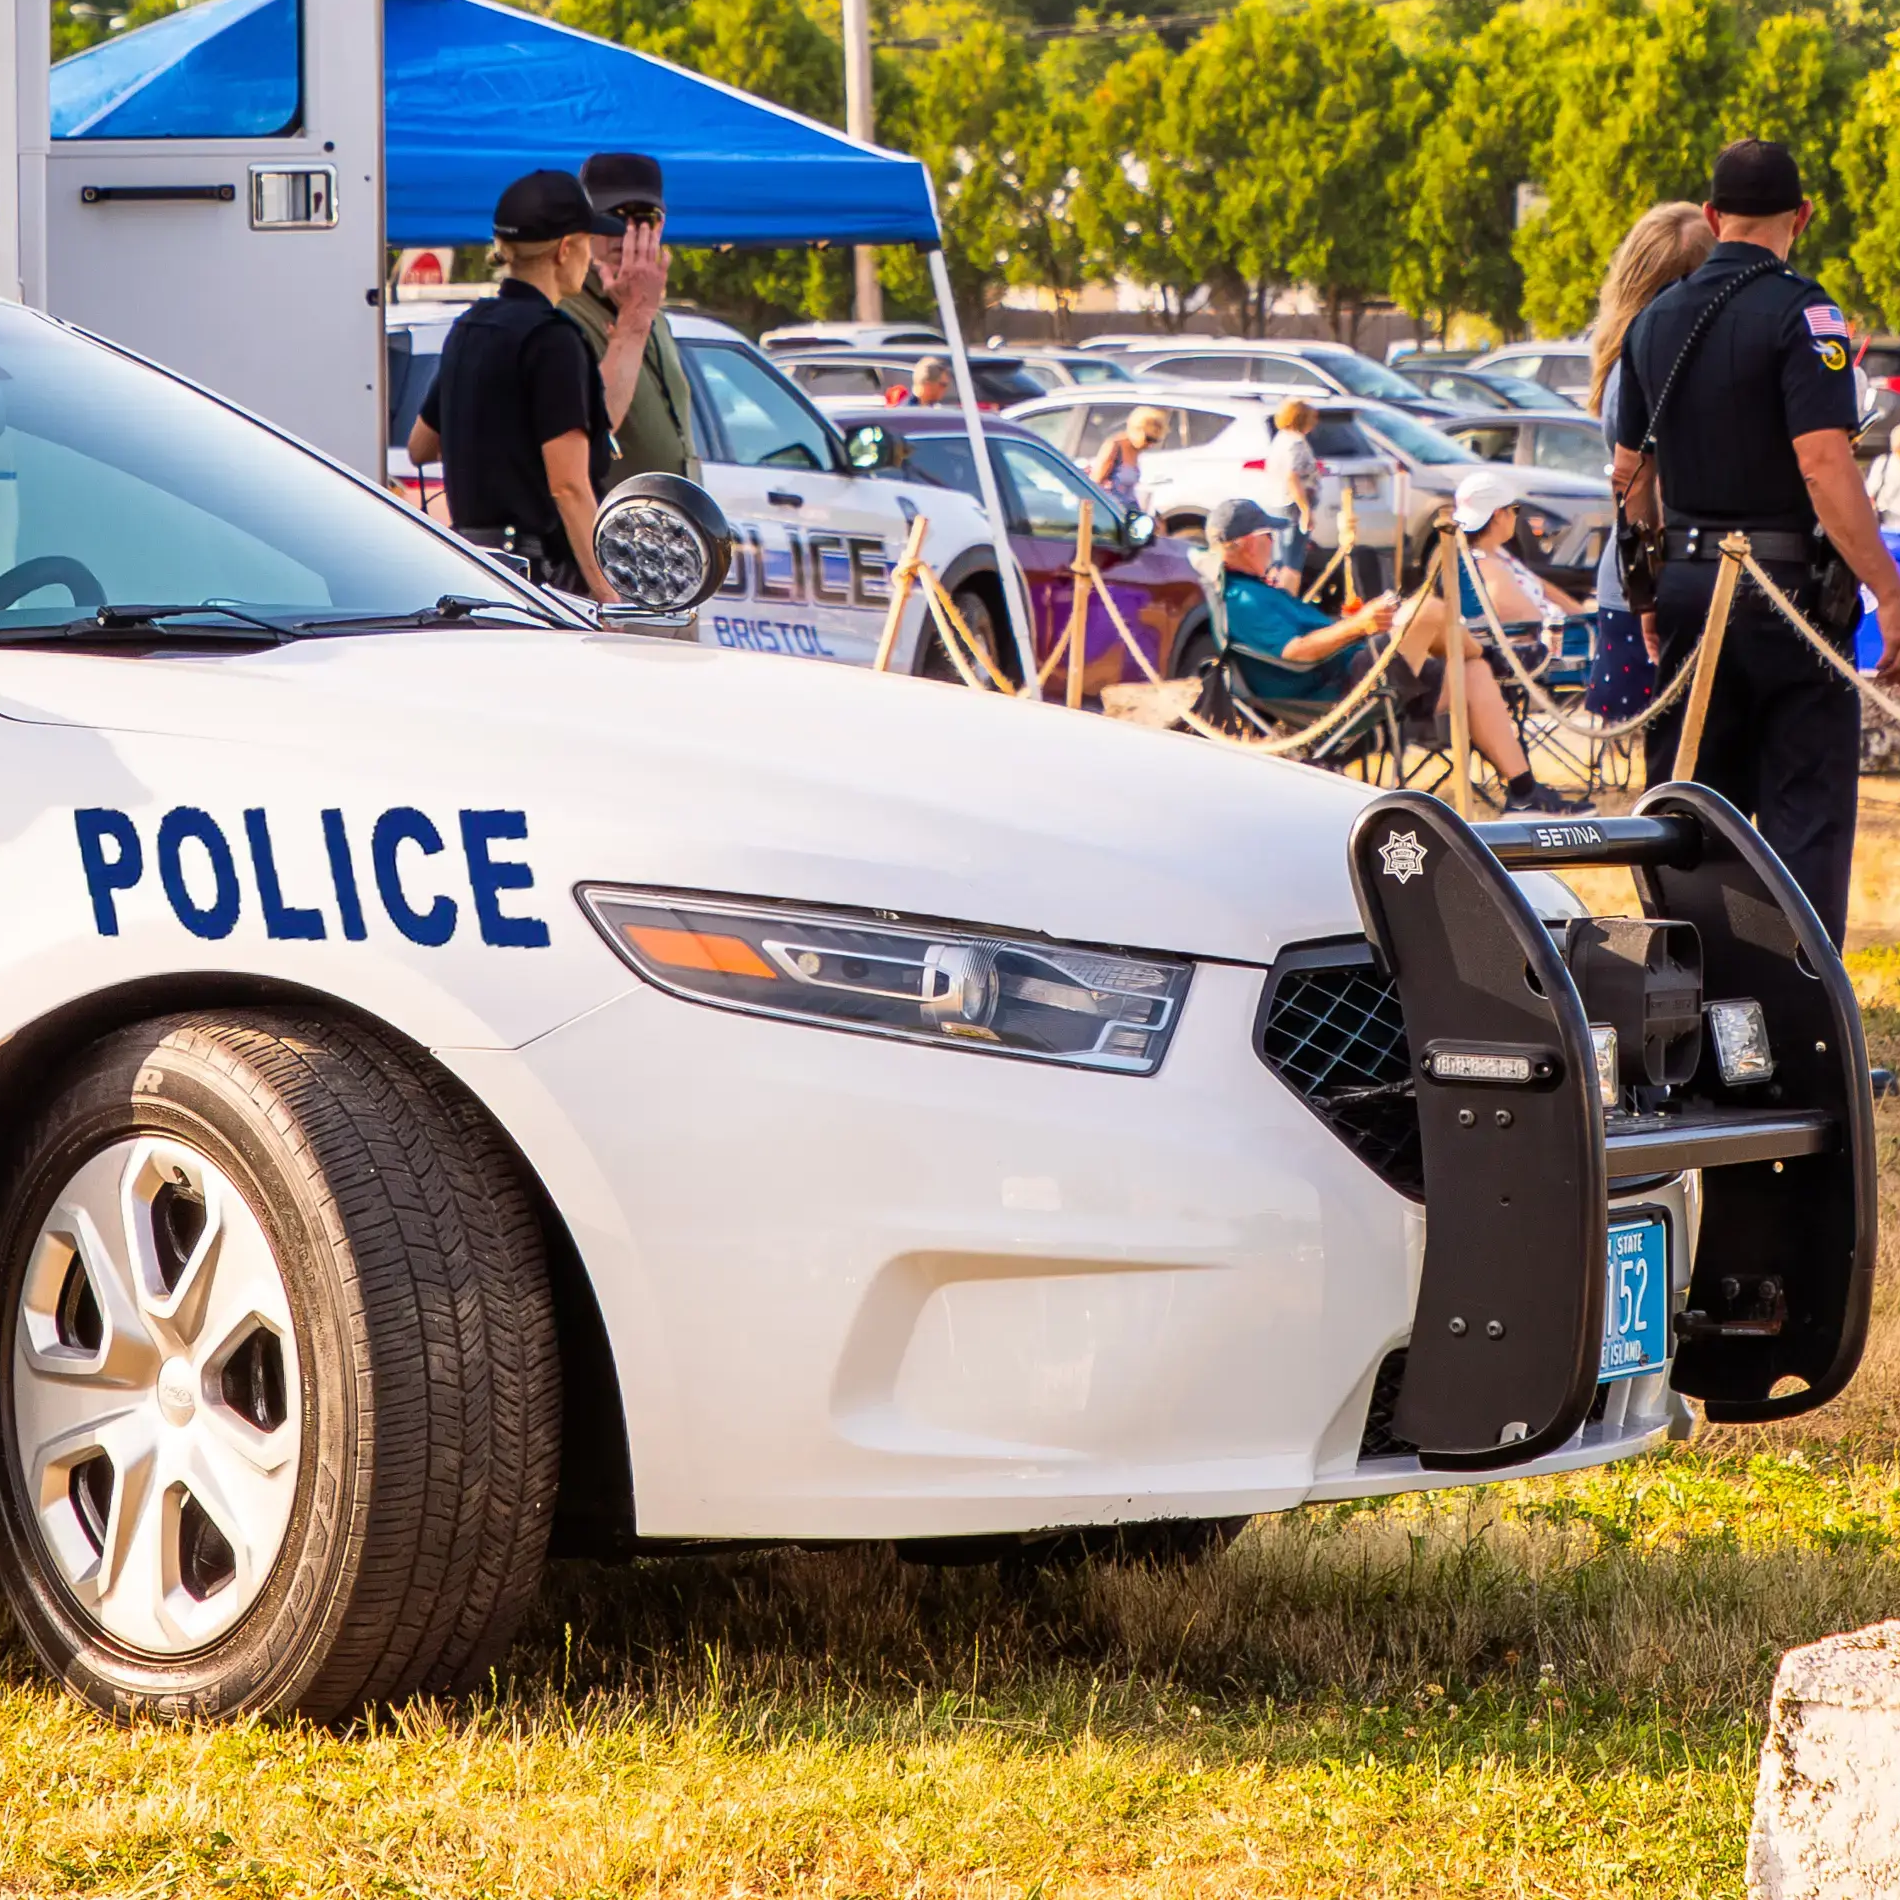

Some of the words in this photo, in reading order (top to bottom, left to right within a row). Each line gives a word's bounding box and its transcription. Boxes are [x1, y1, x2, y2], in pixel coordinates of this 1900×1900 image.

[712, 523, 893, 611] OLICE
[713, 616, 835, 656] BRISTOL
[1536, 825, 1602, 847] SETINA
[74, 805, 550, 948] POLICE
[1616, 1233, 1643, 1255] STATE
[1611, 1340, 1641, 1367] ISLAND
